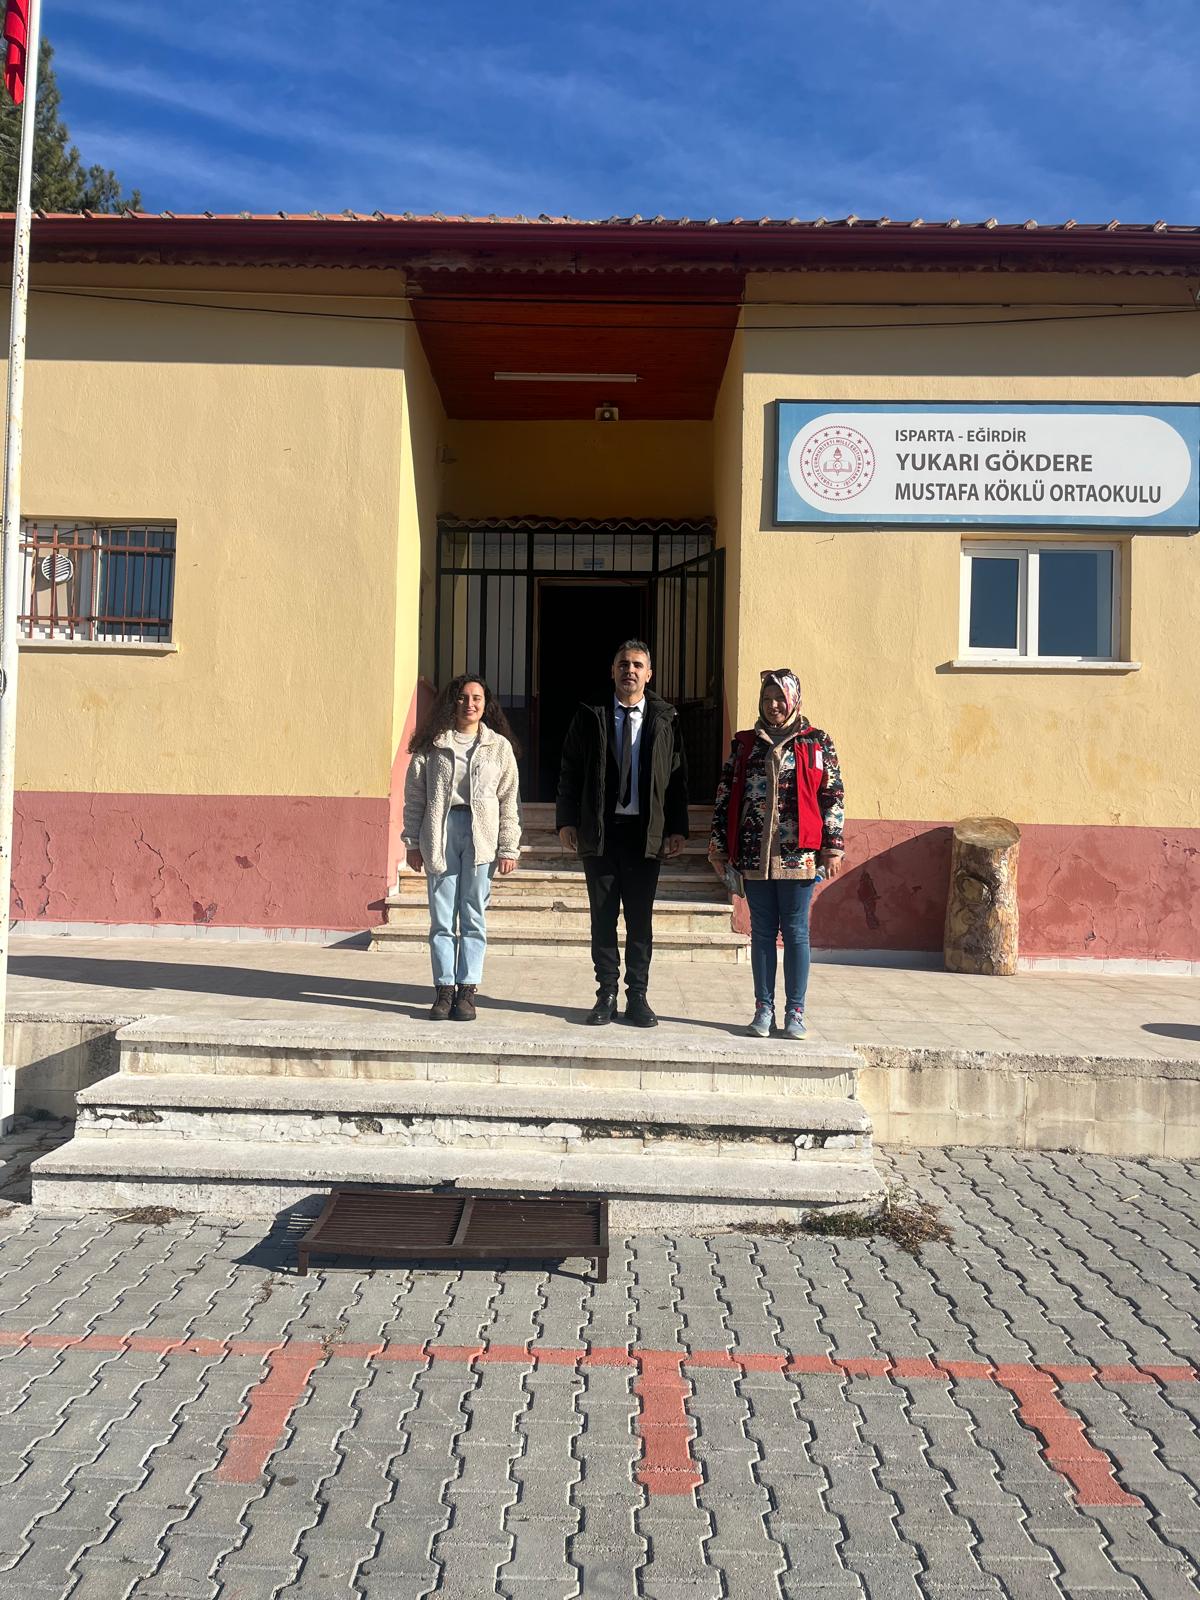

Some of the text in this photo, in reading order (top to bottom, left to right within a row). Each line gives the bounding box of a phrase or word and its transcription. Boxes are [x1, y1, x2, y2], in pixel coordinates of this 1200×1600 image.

[895, 429, 955, 442] ISPARTA
[967, 426, 1026, 443] EĞİRDİR
[895, 449, 1093, 472] YUKARI GÖKDERE
[895, 478, 1162, 504] MUSTAFA KÖKLÜ ORTAOKULU
